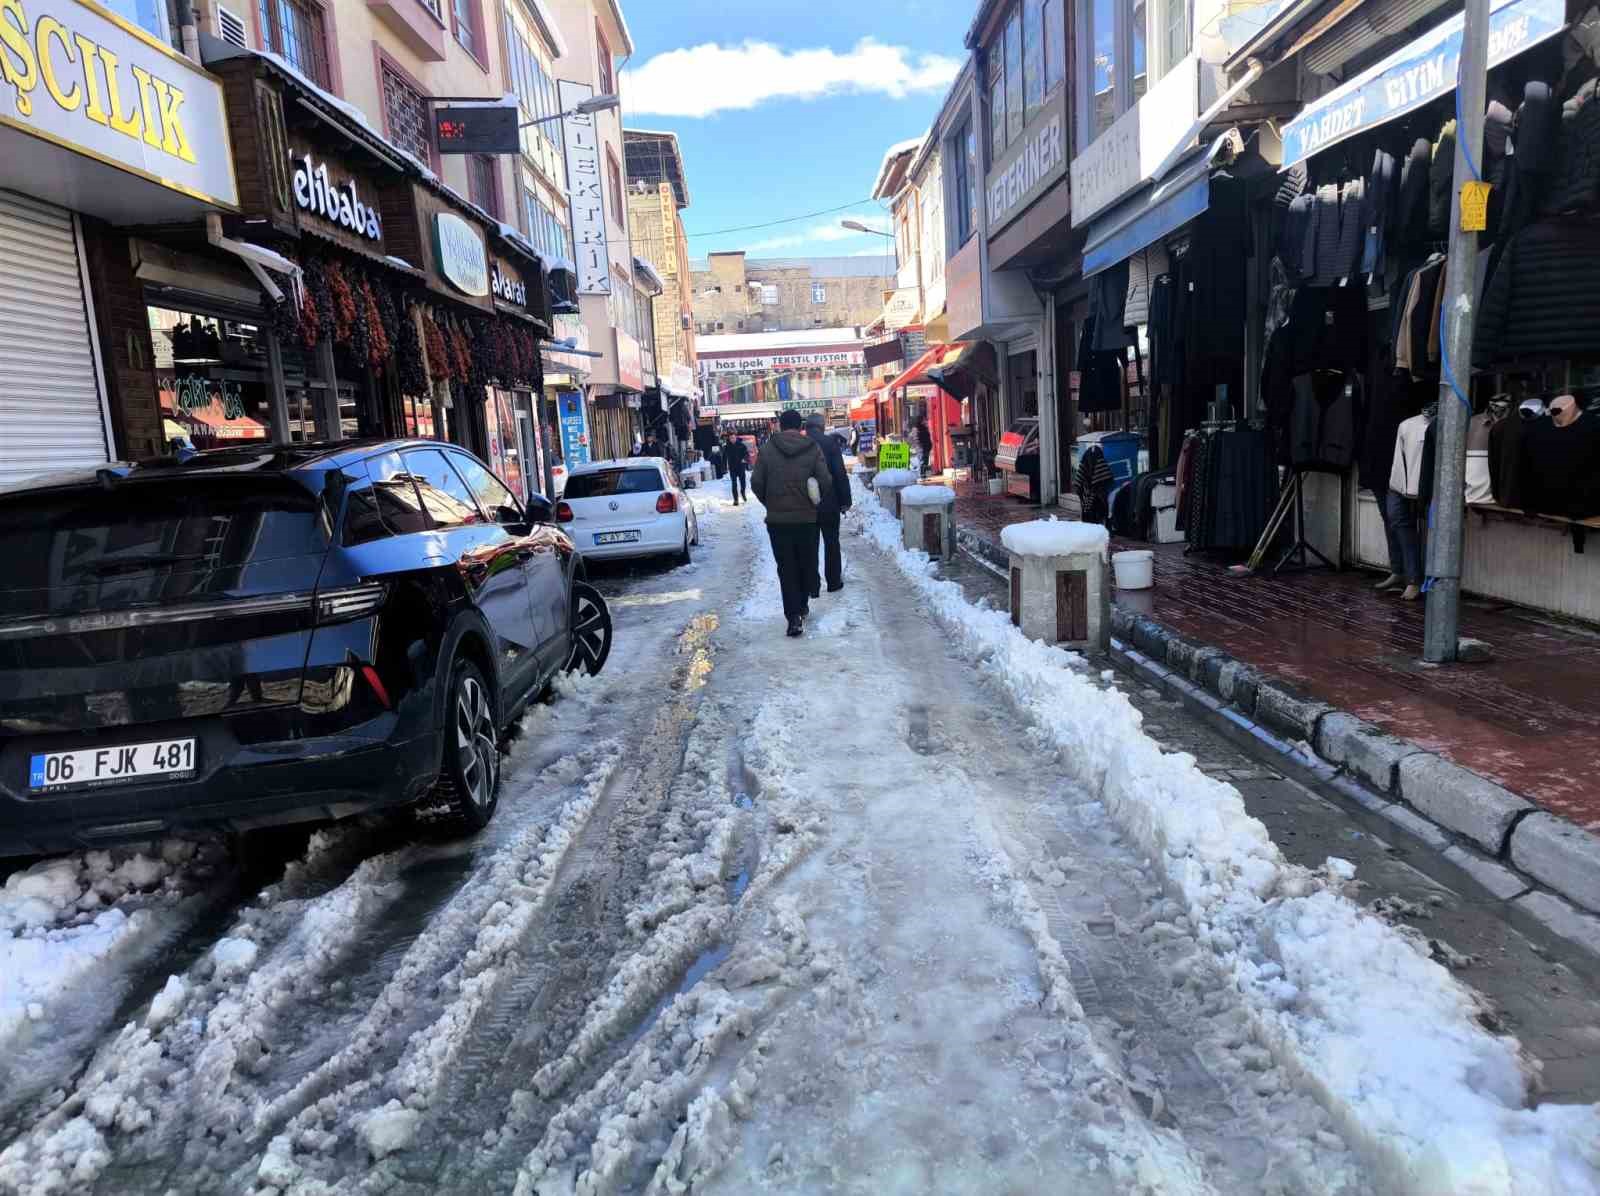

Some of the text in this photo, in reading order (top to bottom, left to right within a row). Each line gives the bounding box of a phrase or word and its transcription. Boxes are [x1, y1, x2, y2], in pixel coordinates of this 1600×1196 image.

[0, 0, 197, 165] ŞCILIK
[291, 150, 381, 241] elibaba
[986, 113, 1062, 226] VETERİNER
[46, 742, 192, 782] 06 FJK 481
